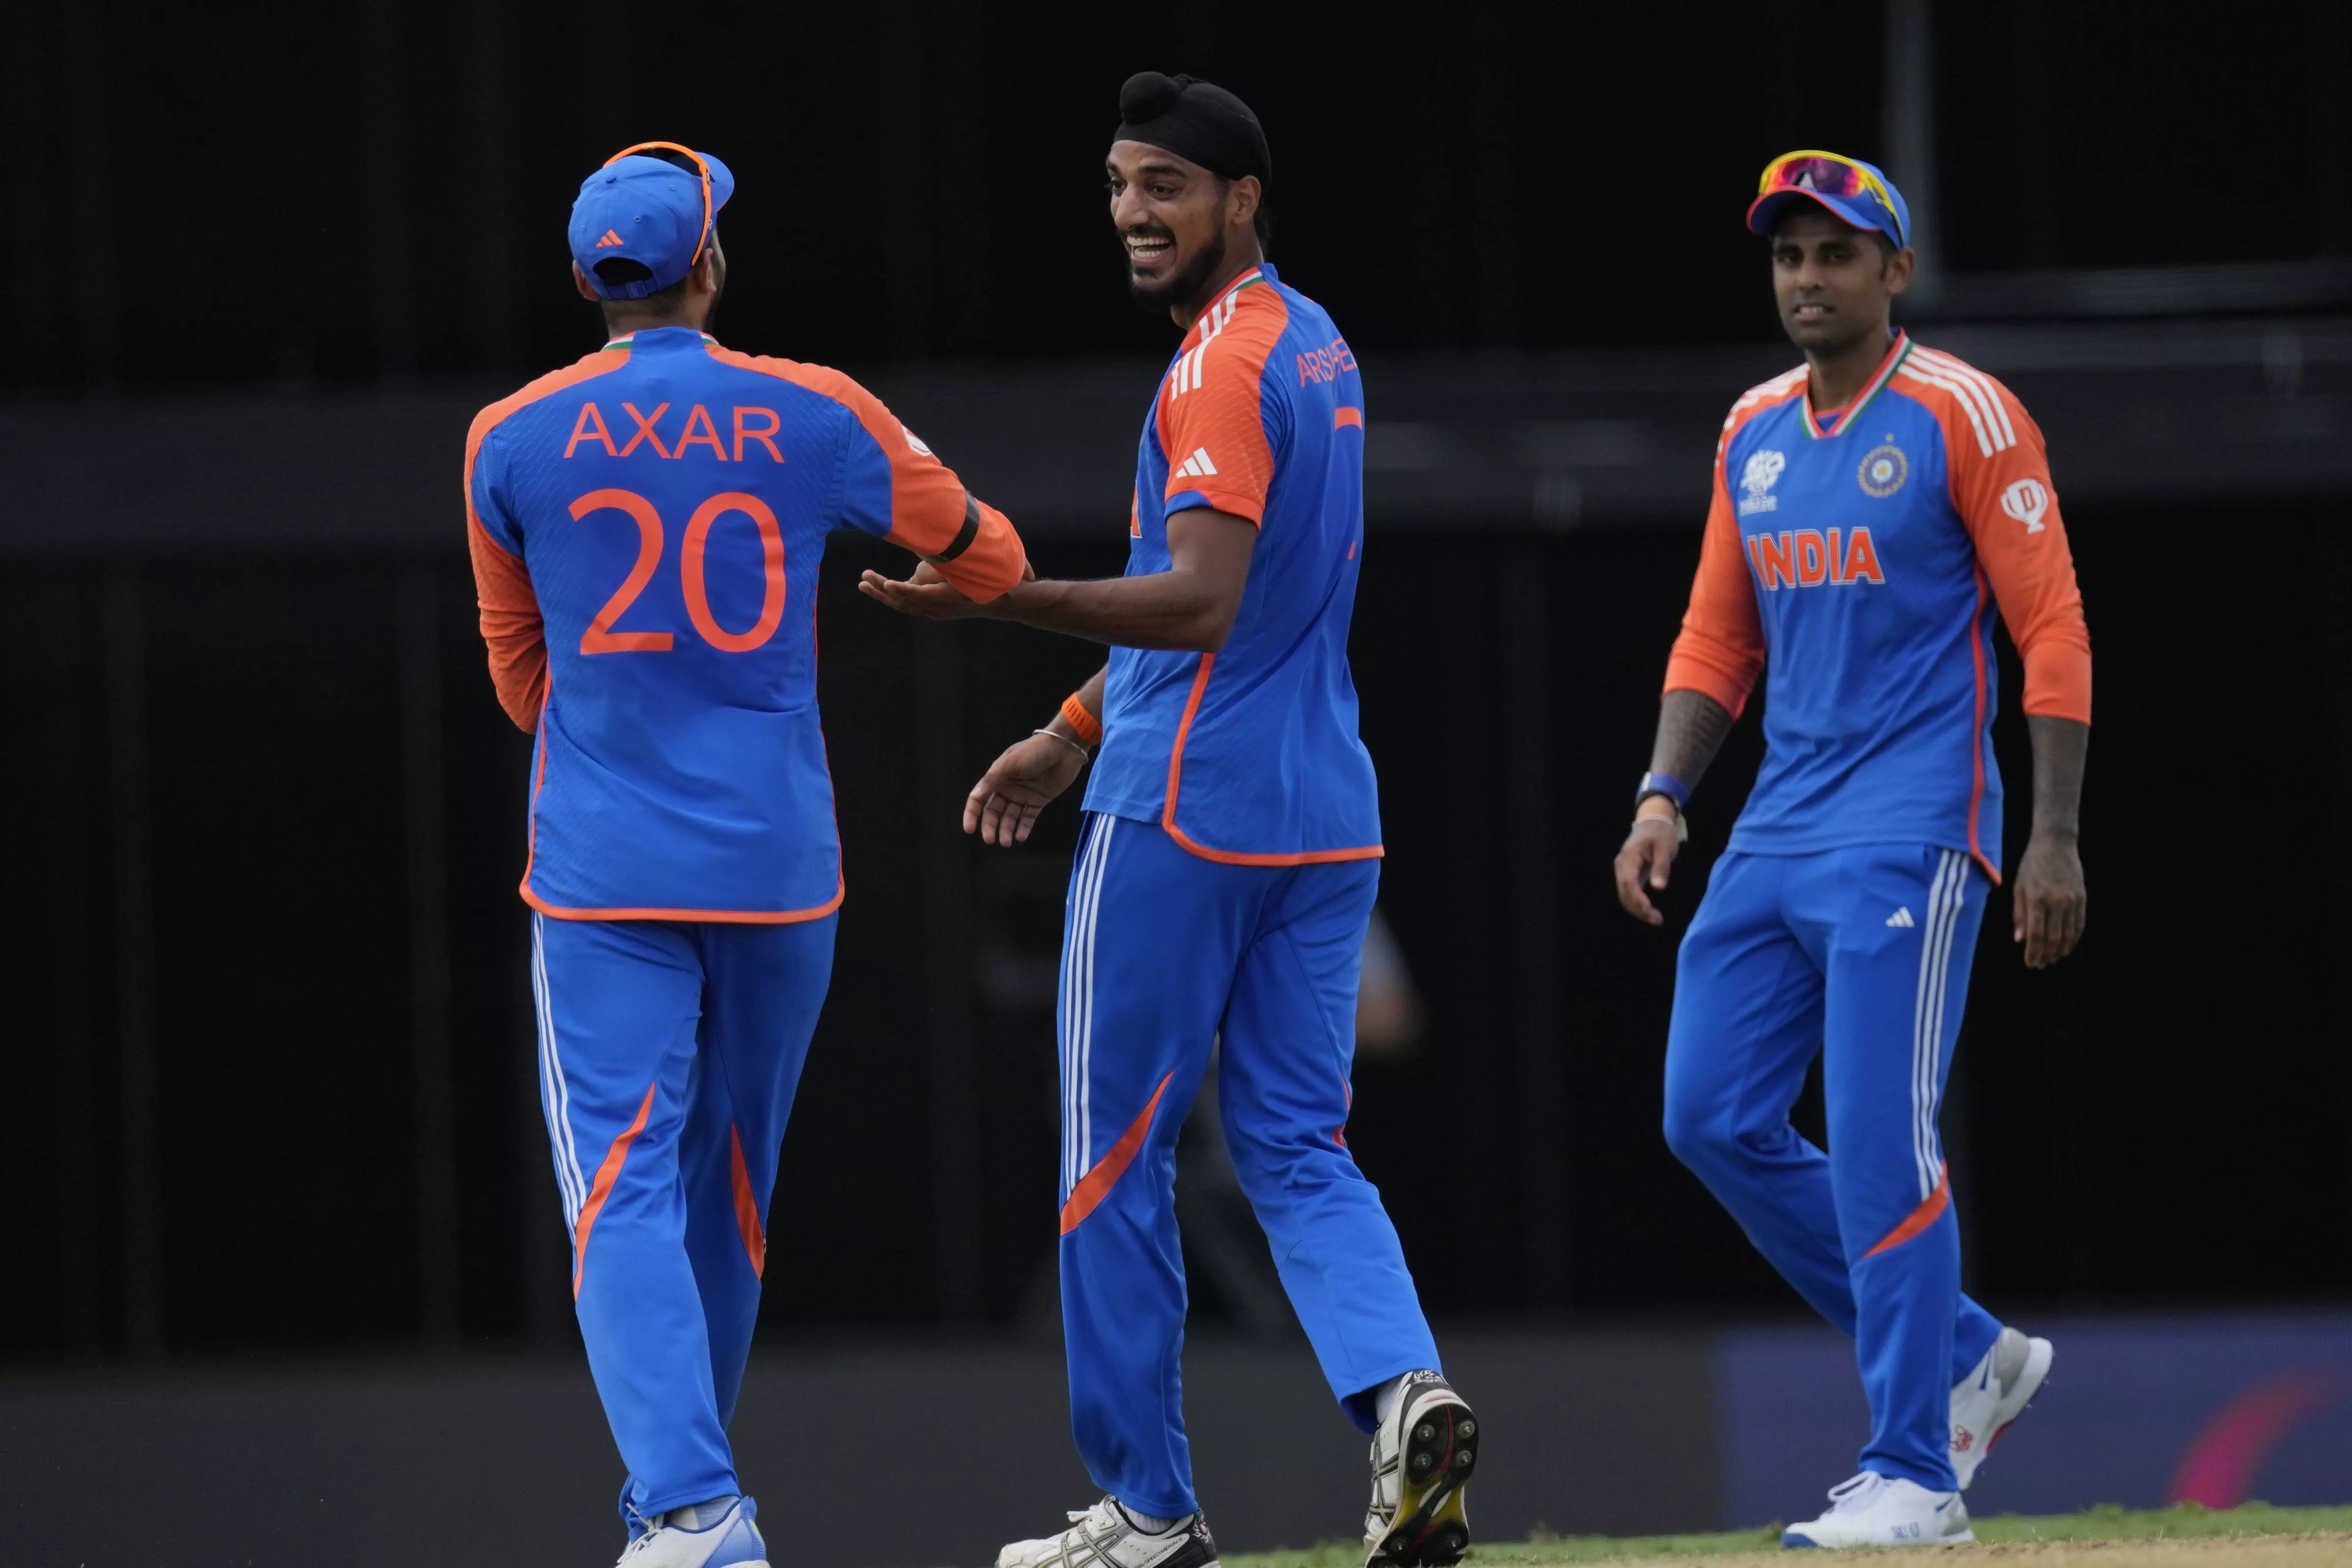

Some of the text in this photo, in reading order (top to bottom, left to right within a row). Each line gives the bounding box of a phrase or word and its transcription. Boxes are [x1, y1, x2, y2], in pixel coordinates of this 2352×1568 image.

[564, 403, 786, 463] AXAR
[568, 488, 786, 654] 20
[1747, 527, 1886, 591] INDIA
